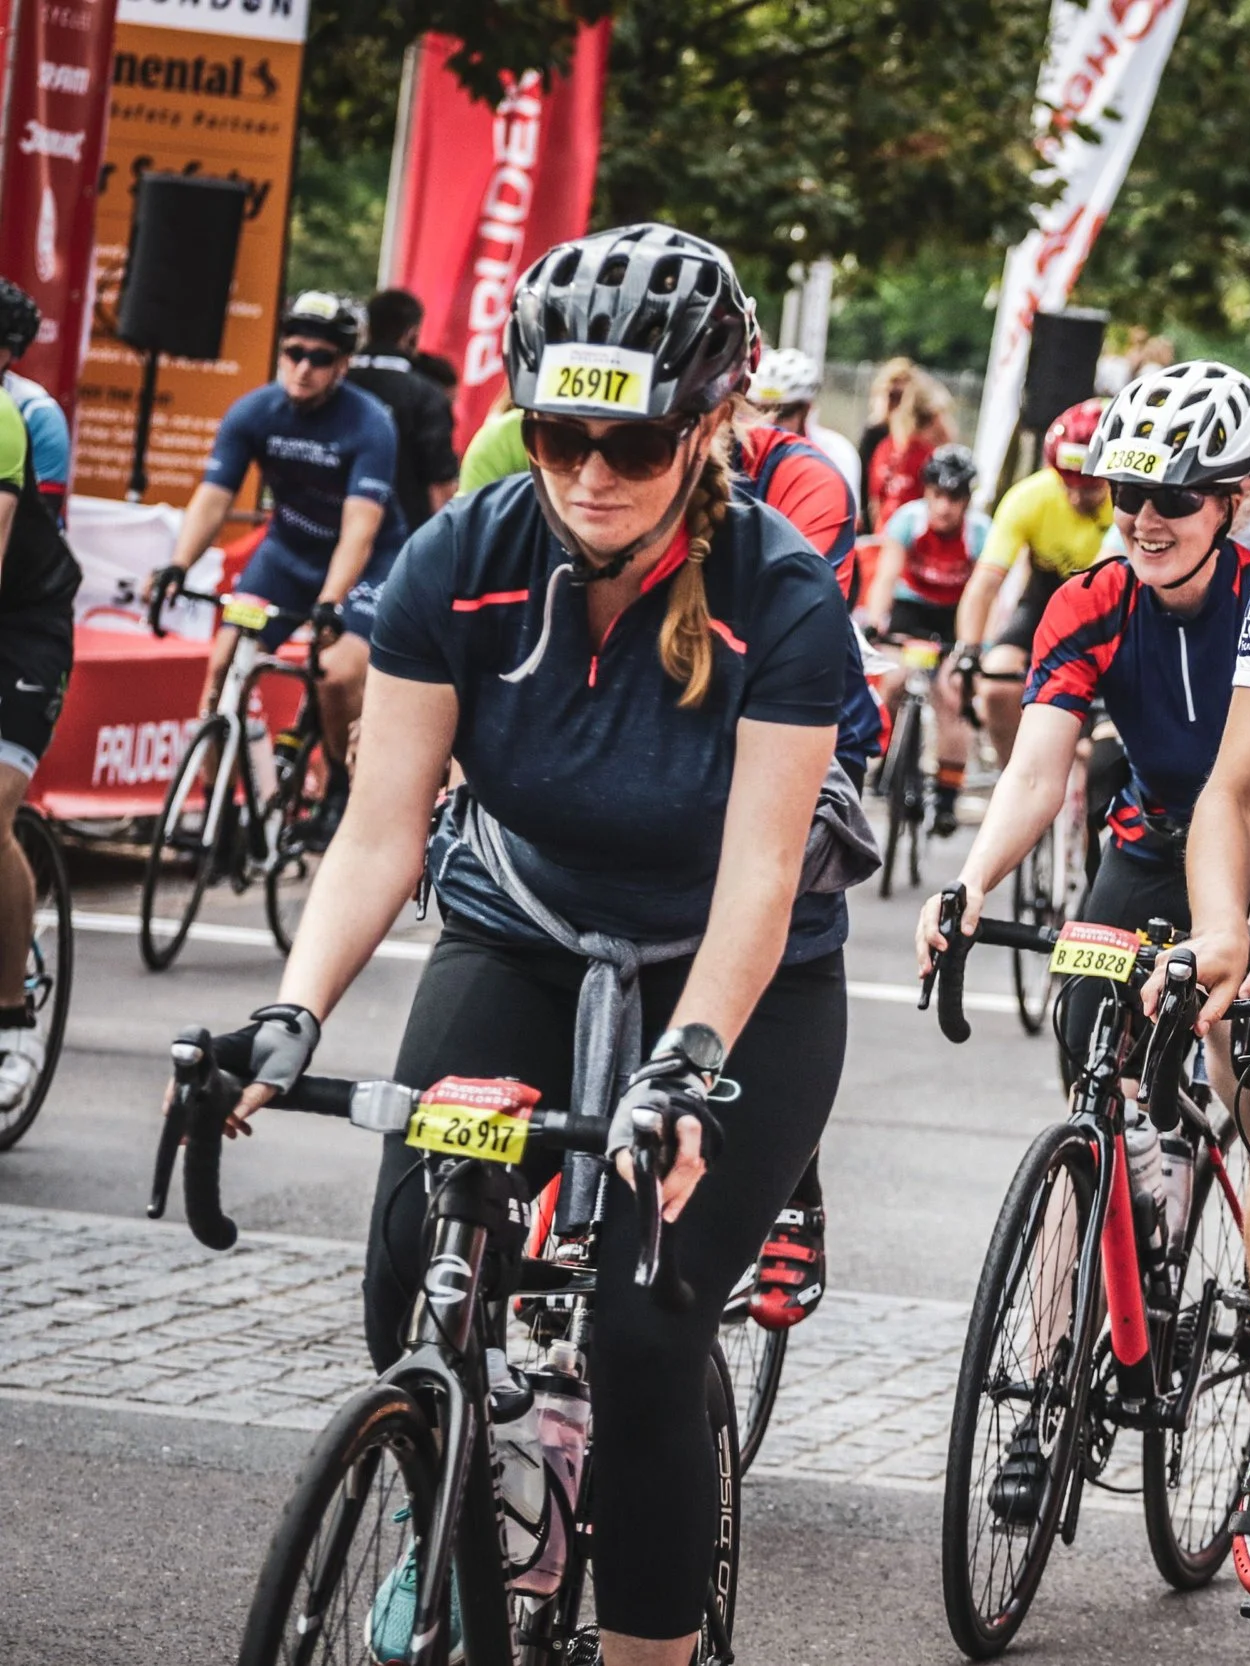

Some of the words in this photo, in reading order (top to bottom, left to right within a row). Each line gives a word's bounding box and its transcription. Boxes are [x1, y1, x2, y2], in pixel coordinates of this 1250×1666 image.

[556, 366, 630, 402] 26917
[1106, 449, 1156, 474] 23828
[1056, 949, 1067, 966] B
[1072, 949, 1127, 974] 23828
[442, 1117, 515, 1153] 26917
